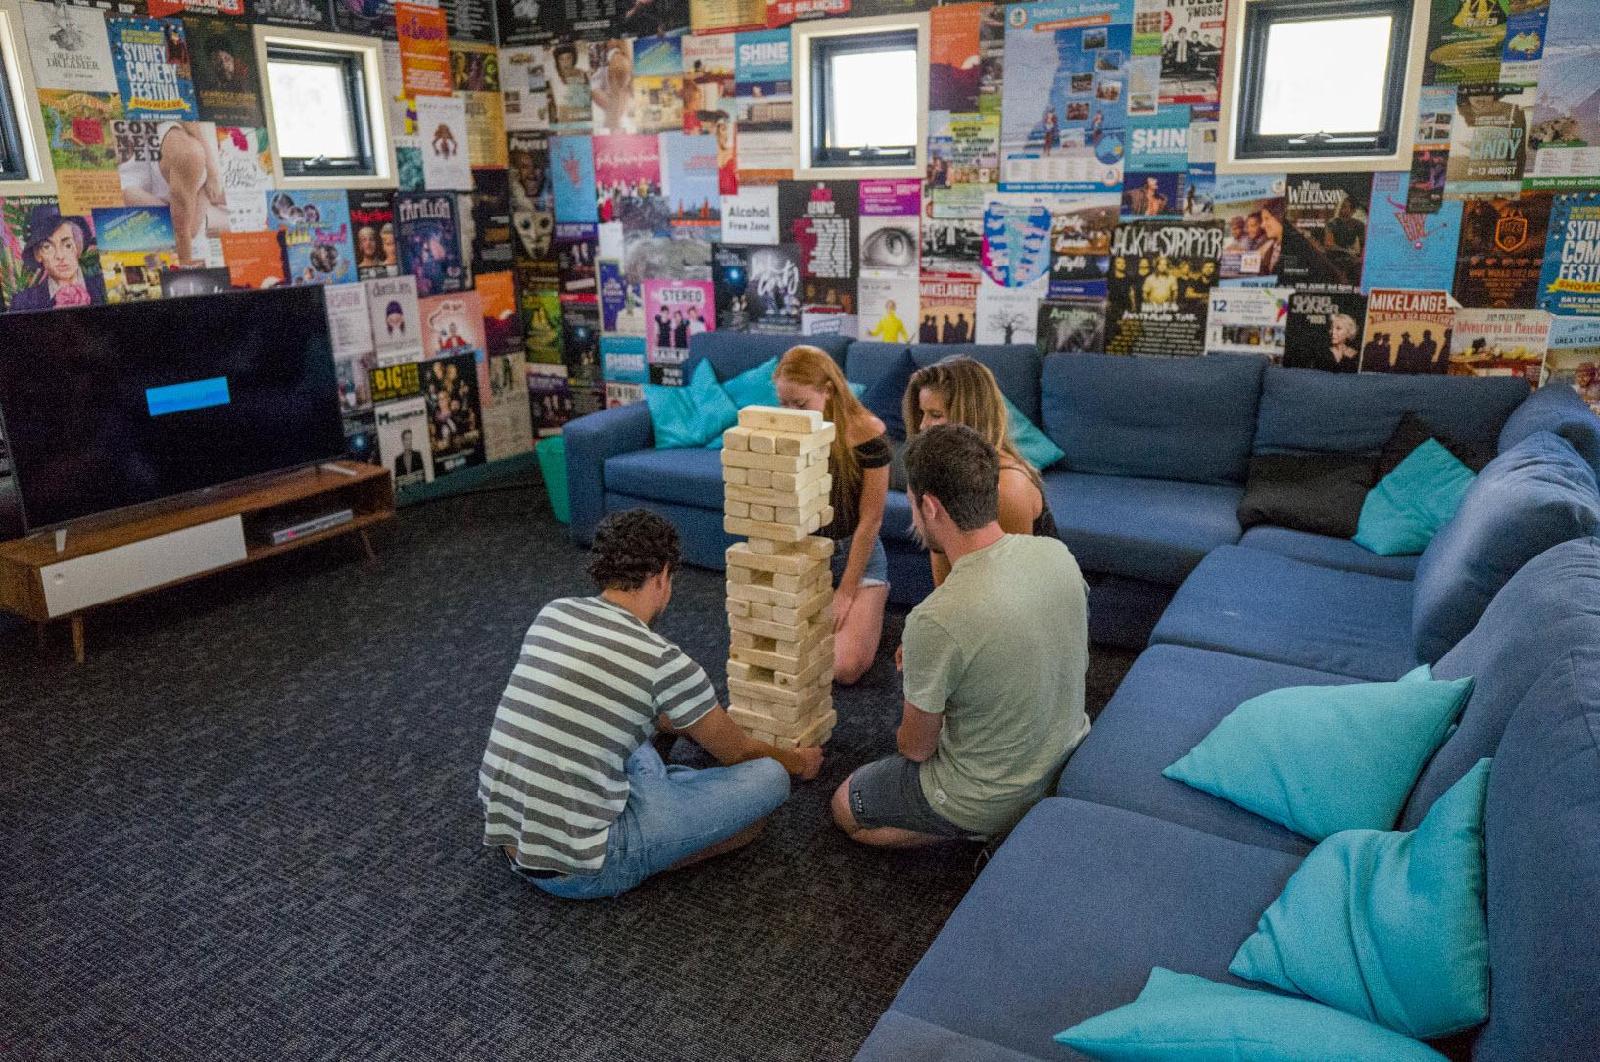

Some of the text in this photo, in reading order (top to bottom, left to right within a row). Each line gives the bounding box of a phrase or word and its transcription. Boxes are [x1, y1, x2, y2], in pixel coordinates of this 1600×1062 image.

[1193, 4, 1223, 17] MUSIC
[122, 43, 167, 63] SYDNEY
[740, 42, 789, 63] SHINE
[125, 61, 178, 83] COMEDY
[130, 82, 181, 101] FESTIVAL
[113, 121, 158, 135] CON
[1511, 127, 1523, 139] TO
[116, 135, 160, 148] NEC
[120, 149, 162, 162] TED
[1487, 167, 1517, 176] AUGUST
[1577, 178, 1600, 186] onlin
[728, 205, 770, 218] Alcohol
[729, 220, 770, 232] Free Zone
[1159, 227, 1223, 261] STRIPPER
[661, 290, 703, 302] STEREO
[1212, 300, 1228, 312] 12
[1370, 294, 1455, 313] MIKELANGE
[374, 366, 402, 391] BIG
